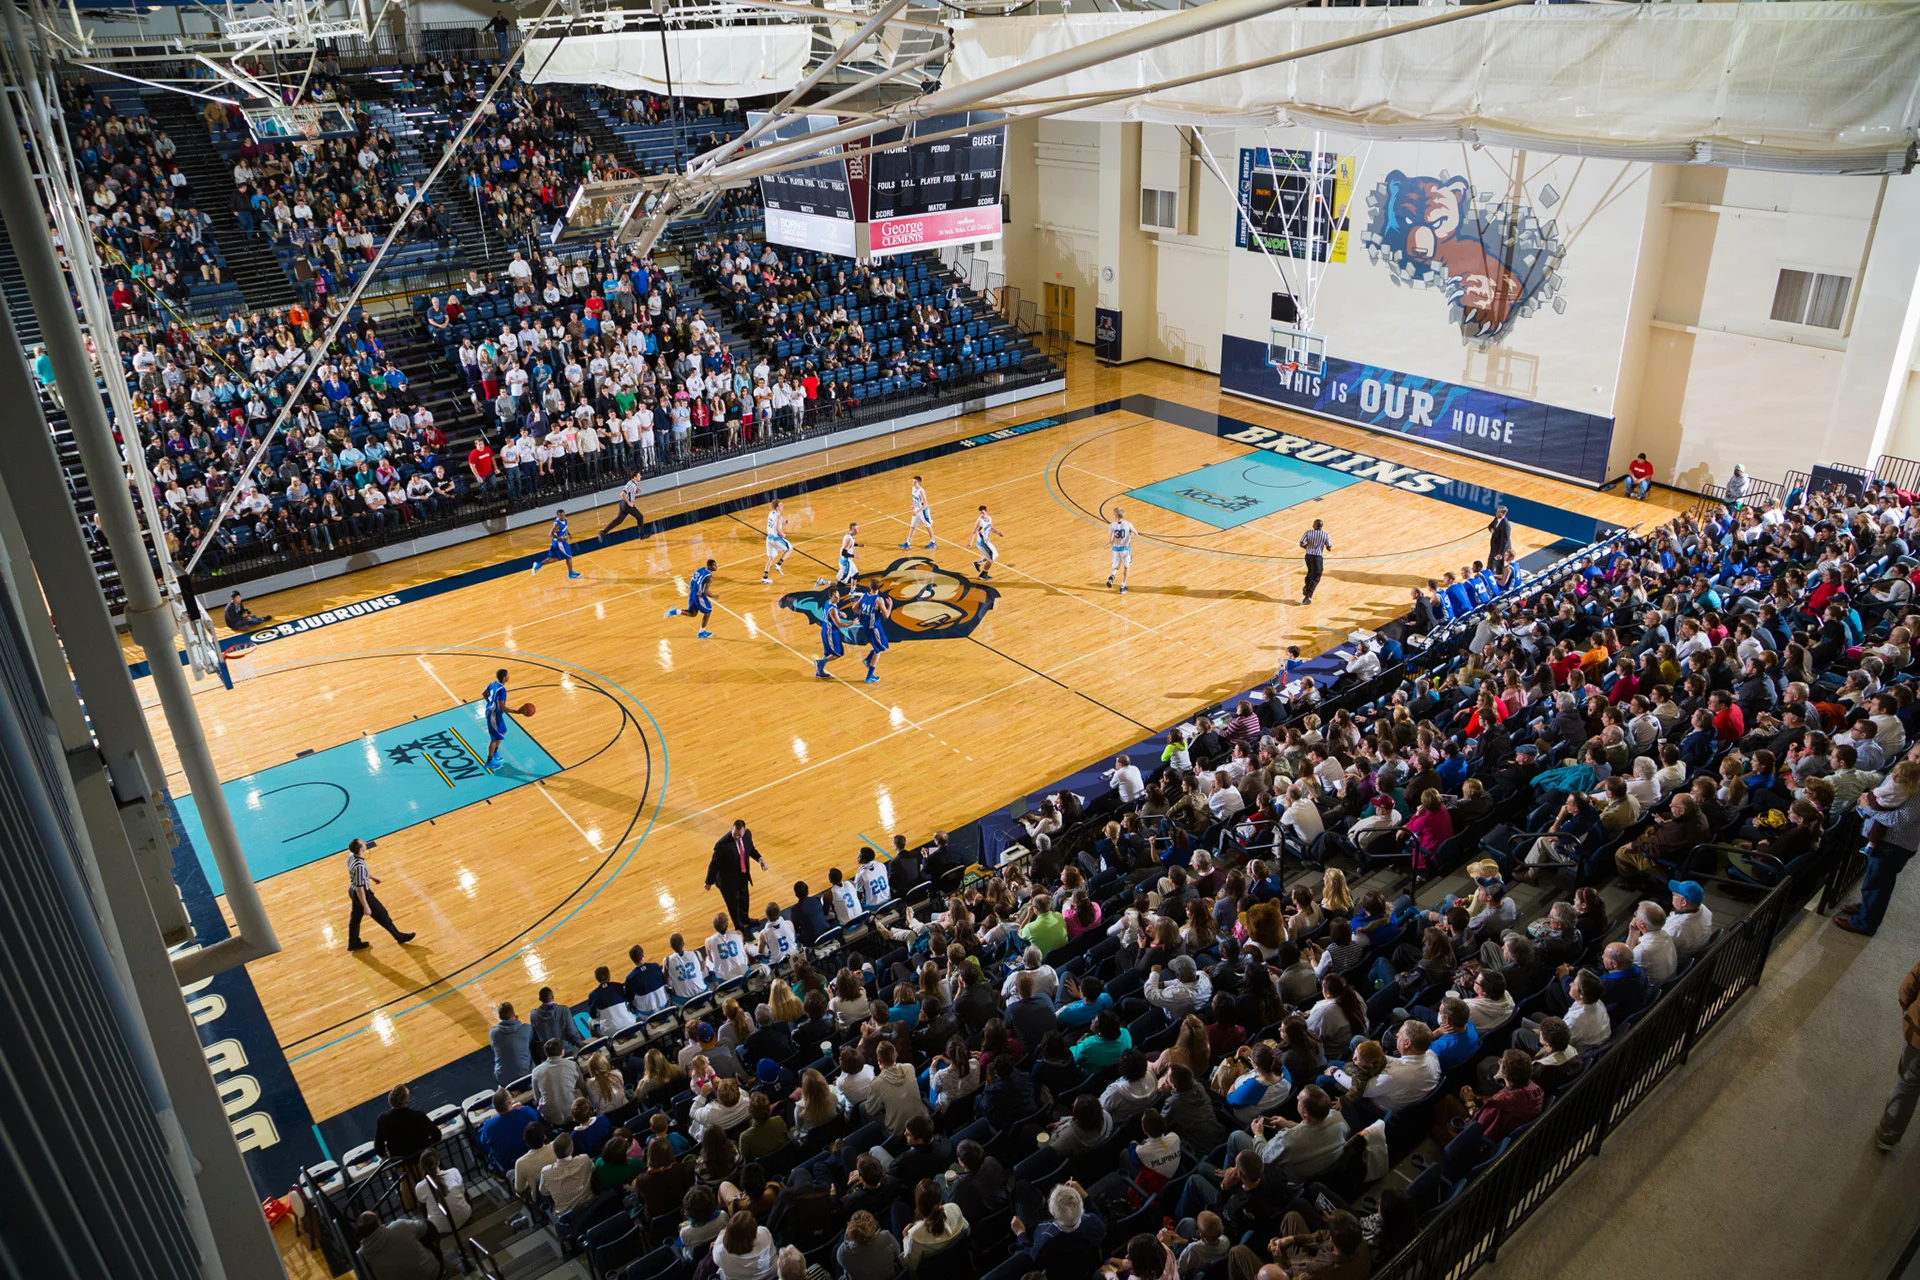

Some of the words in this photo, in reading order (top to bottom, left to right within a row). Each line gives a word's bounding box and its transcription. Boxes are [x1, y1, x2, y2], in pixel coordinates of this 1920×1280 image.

[931, 144, 950, 153] PERIOD
[972, 135, 996, 147] GUEST
[878, 181, 896, 190] FOULS
[901, 179, 916, 188] T.O.L.
[920, 176, 940, 186] PLAYER
[943, 175, 956, 183] FOUL
[961, 173, 975, 181] T.O.L.
[980, 170, 996, 179] FOULS
[928, 203, 947, 212] MATCH
[978, 197, 994, 206] SCORE
[875, 209, 894, 219] SCORE
[882, 221, 924, 236] George
[882, 233, 924, 246] CLEMENTS
[1284, 371, 1321, 397] HIS
[1331, 381, 1348, 403] IS
[1360, 378, 1434, 428] OUR
[1452, 410, 1514, 445] HOUSE
[1223, 425, 1454, 493] BRUINS
[1114, 529, 1126, 539] 30
[250, 594, 401, 642] @BJUBRUINS
[420, 730, 485, 781] NCCAA
[870, 875, 887, 895] 20
[842, 892, 855, 908] 3
[717, 941, 738, 960] 50
[778, 936, 789, 952] 5
[676, 961, 697, 982] 32
